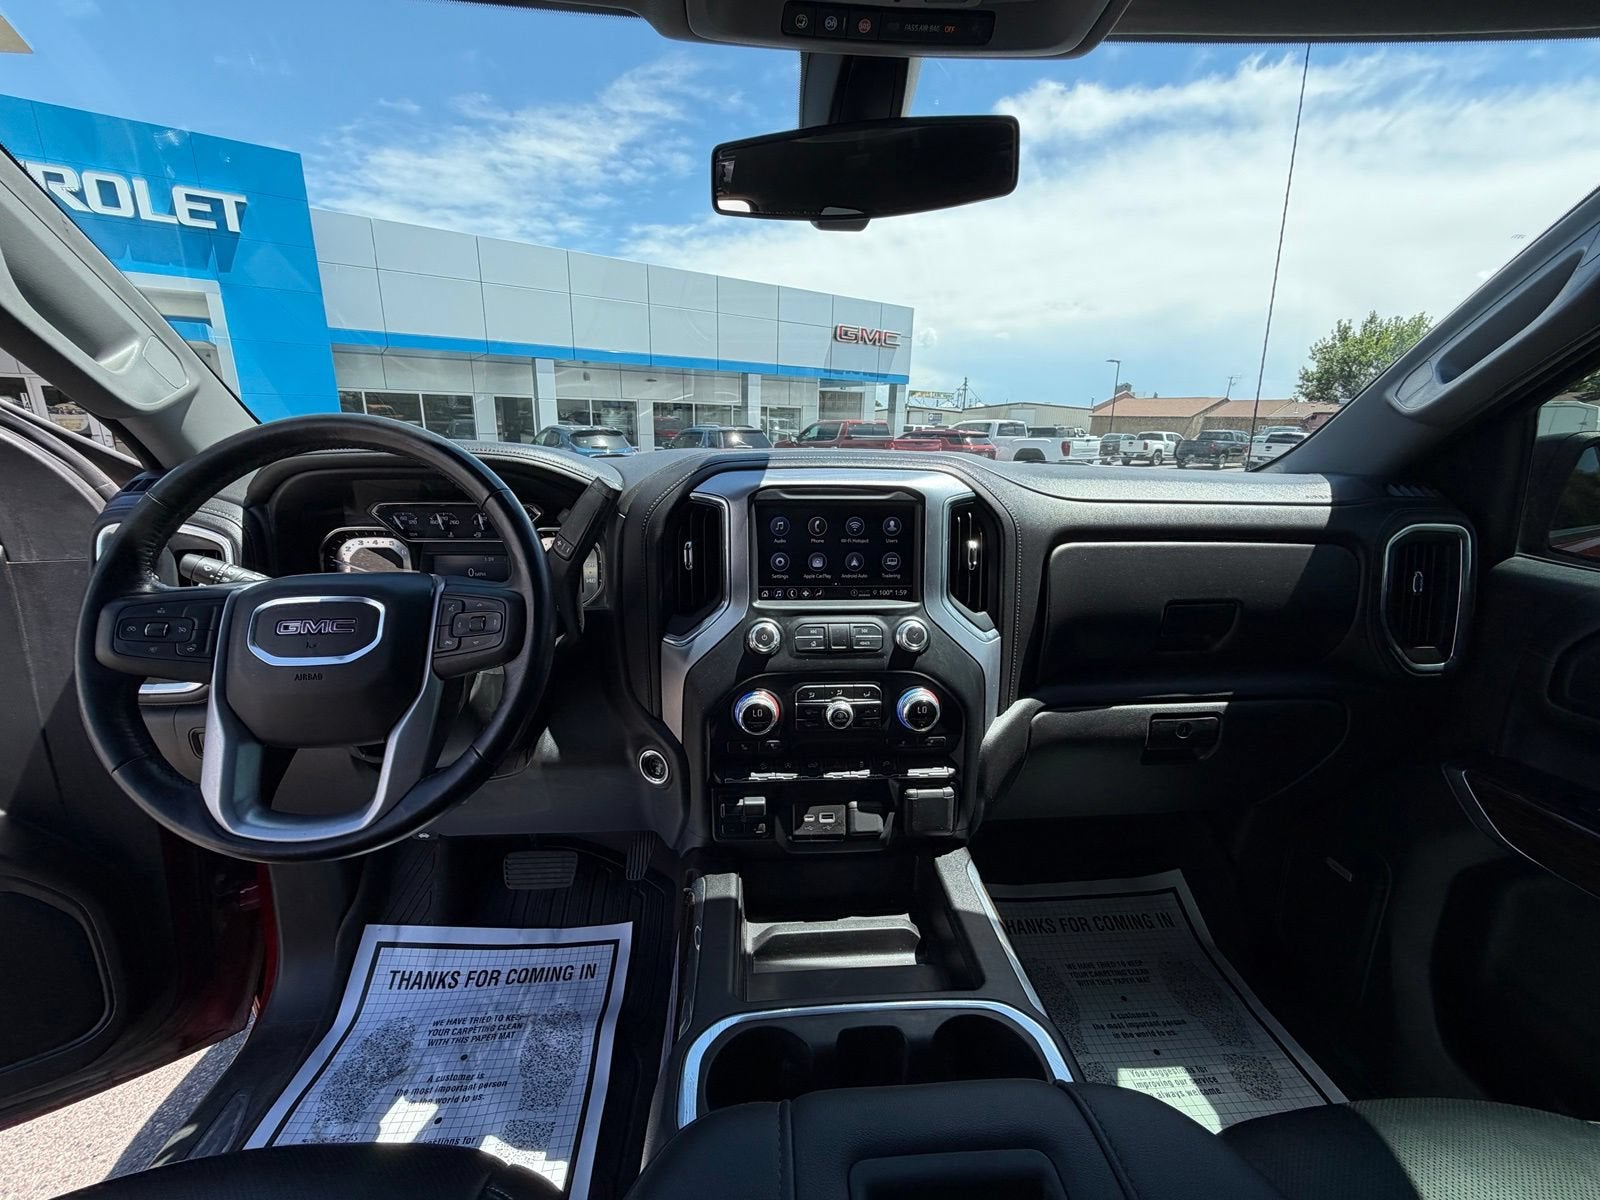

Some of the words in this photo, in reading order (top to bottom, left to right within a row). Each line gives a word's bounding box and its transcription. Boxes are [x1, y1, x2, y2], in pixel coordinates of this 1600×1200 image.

[944, 25, 956, 33] OFF
[18, 160, 247, 233] ROLET
[835, 323, 901, 348] GMC
[468, 568, 474, 577] 0
[276, 619, 356, 635] GMC
[294, 673, 323, 681] AIRBAG
[1006, 917, 1057, 935] HANKS
[1060, 916, 1092, 933] FOR
[1093, 914, 1154, 932] COMING
[1157, 911, 1175, 928] IN
[389, 970, 461, 990] THANKS
[464, 969, 502, 988] FOR
[505, 965, 574, 985] COMING
[579, 963, 597, 980] IN
[446, 1017, 468, 1025] HAVE
[469, 1015, 491, 1024] TRIED
[427, 1028, 449, 1037] YOUR
[451, 1024, 495, 1035] CARPETING
[497, 1022, 522, 1031] CLEAN
[427, 1038, 449, 1047] WITH
[450, 1036, 470, 1044] THIS
[470, 1033, 496, 1042] PAPER
[498, 1031, 516, 1040] MAT
[1129, 1069, 1149, 1078] Your
[1149, 1066, 1196, 1077] suggestions
[1196, 1065, 1209, 1073] for
[427, 1075, 434, 1083] A
[435, 1073, 475, 1083] customer
[1189, 1075, 1219, 1084] service
[395, 1088, 409, 1097] the
[411, 1086, 433, 1096] most
[434, 1083, 477, 1094] important
[478, 1080, 508, 1089] person
[435, 1095, 460, 1104] world
[1156, 1090, 1185, 1100] always
[462, 1136, 476, 1144] for
